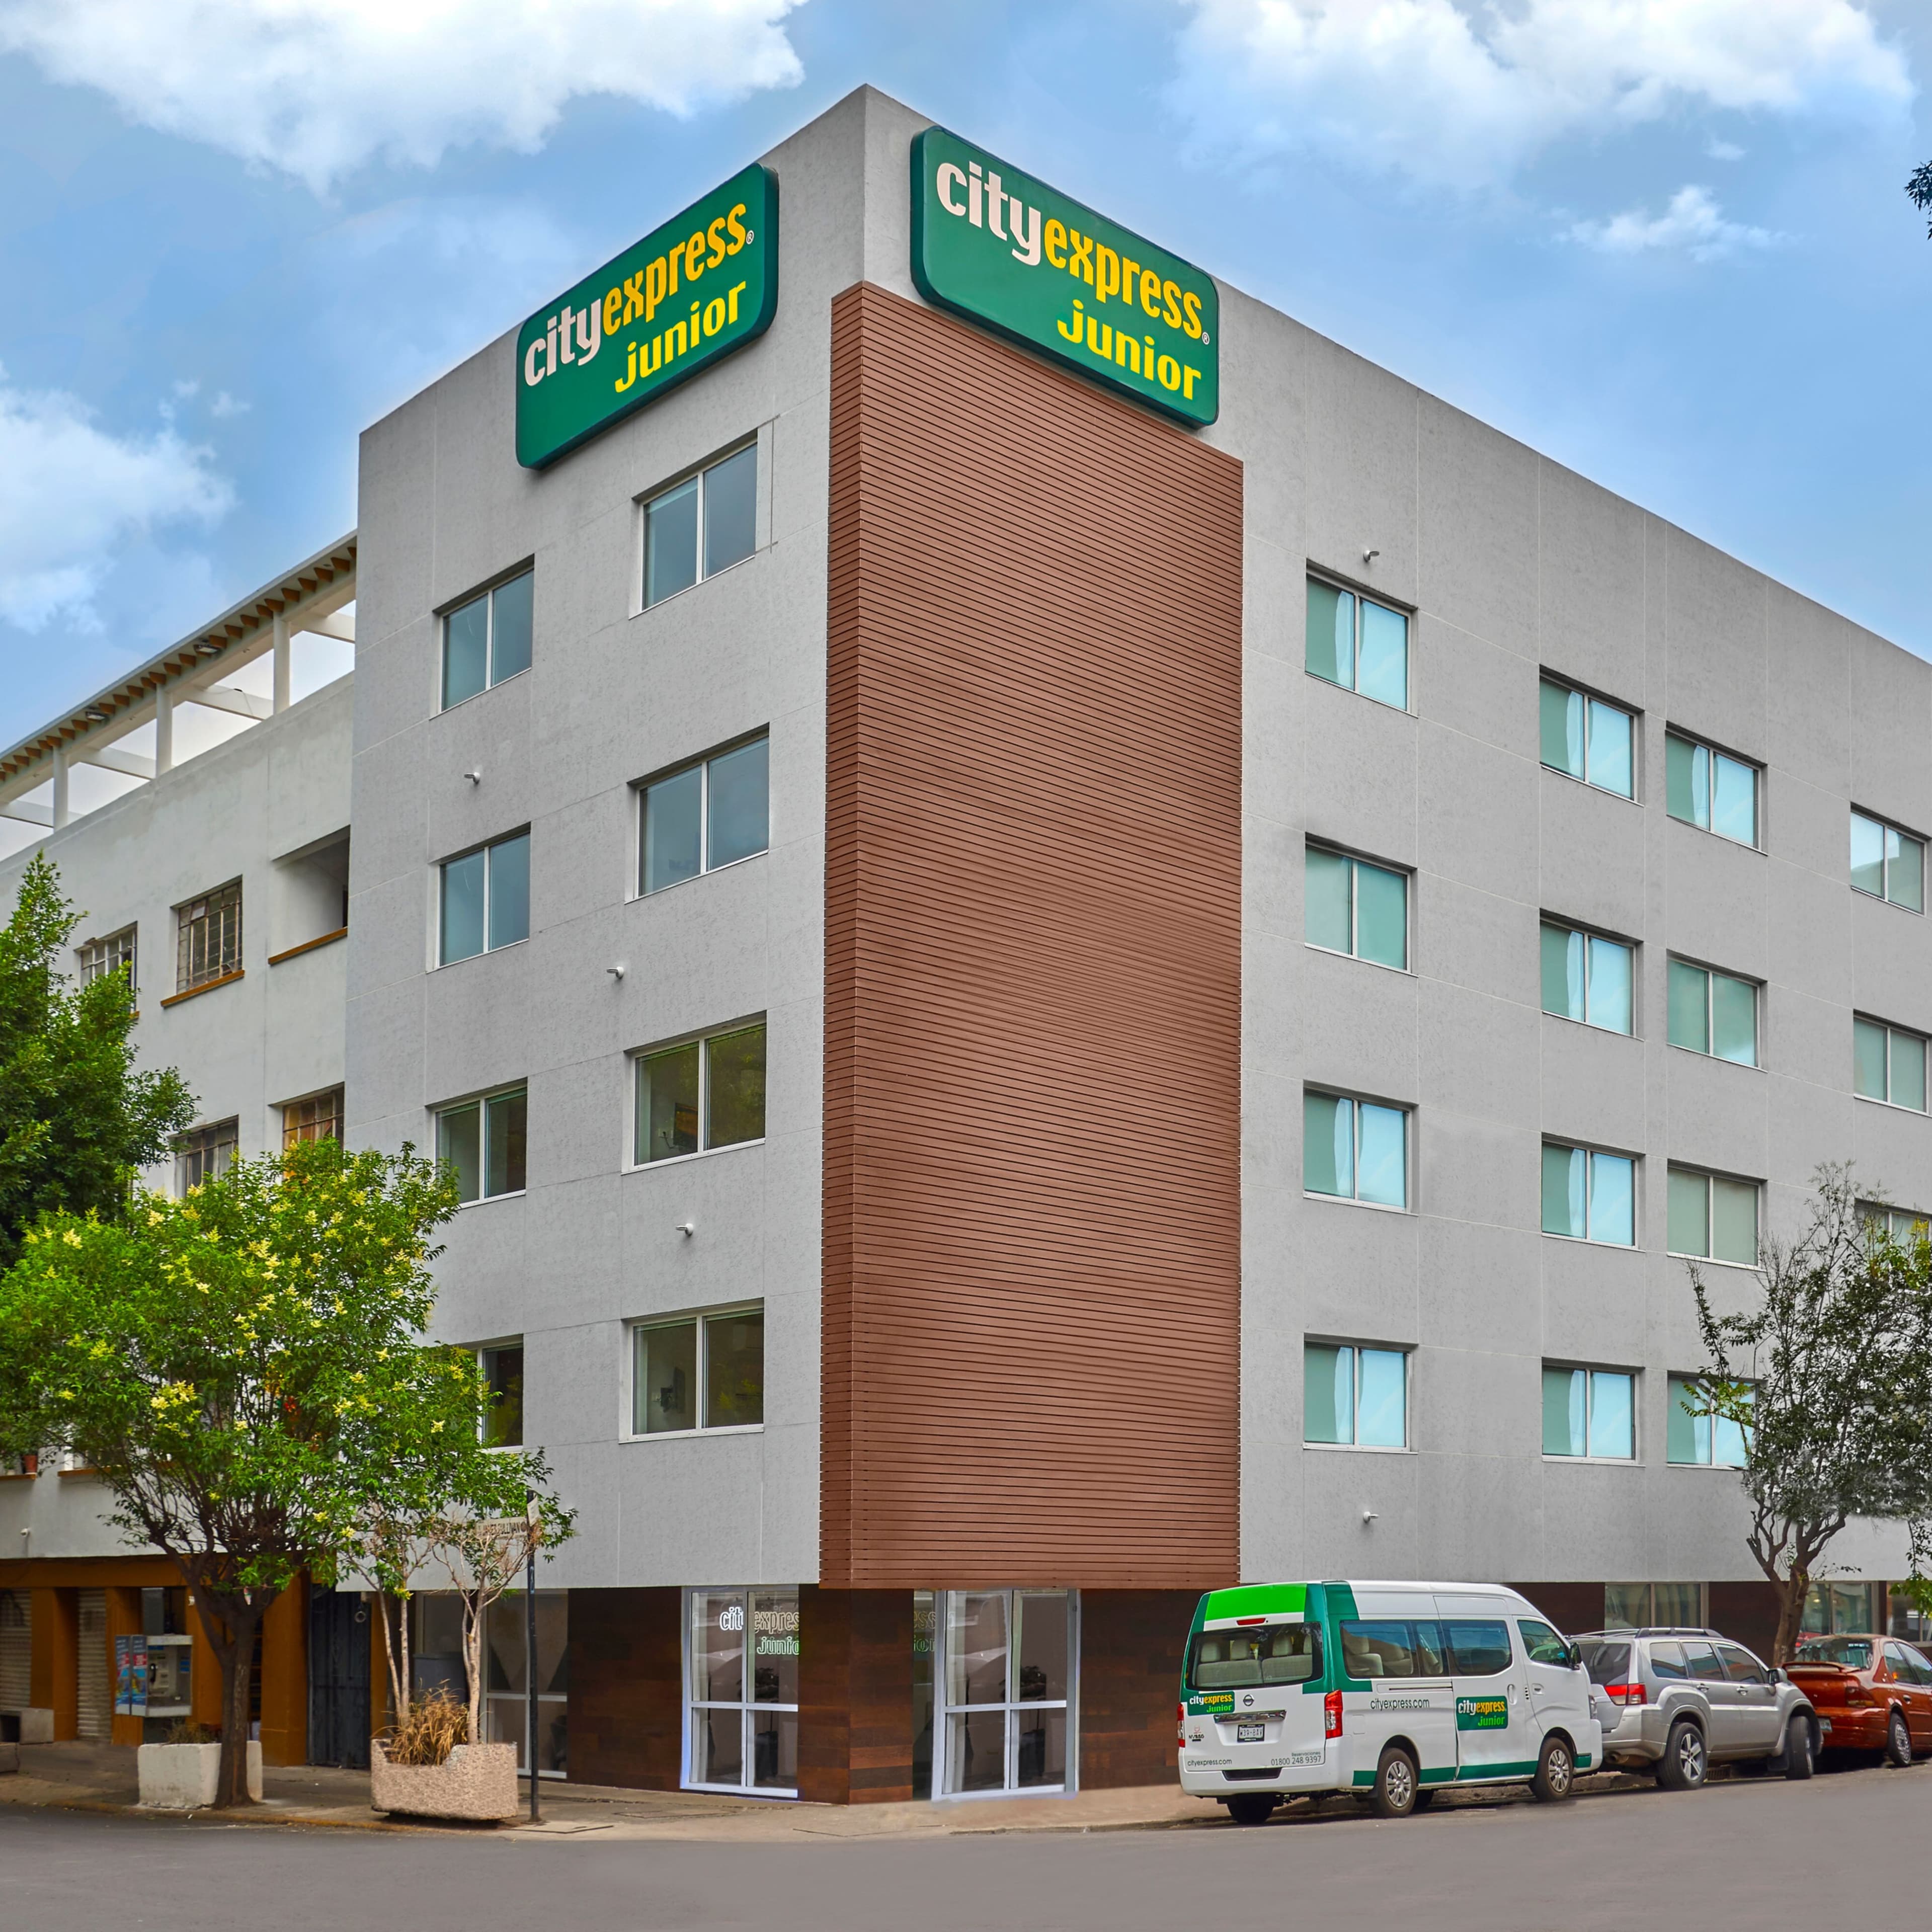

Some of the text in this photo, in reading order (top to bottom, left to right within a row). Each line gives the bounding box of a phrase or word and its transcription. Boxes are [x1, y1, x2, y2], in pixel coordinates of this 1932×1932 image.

[524, 203, 747, 386] cityexpress
[937, 160, 1202, 340] cityexpress
[615, 281, 746, 393] junior
[1057, 299, 1201, 400] junior
[1370, 1698, 1430, 1711] cityexpress.com
[1458, 1700, 1506, 1716] cityexpress
[1271, 1755, 1321, 1766] 01800 248 9397
